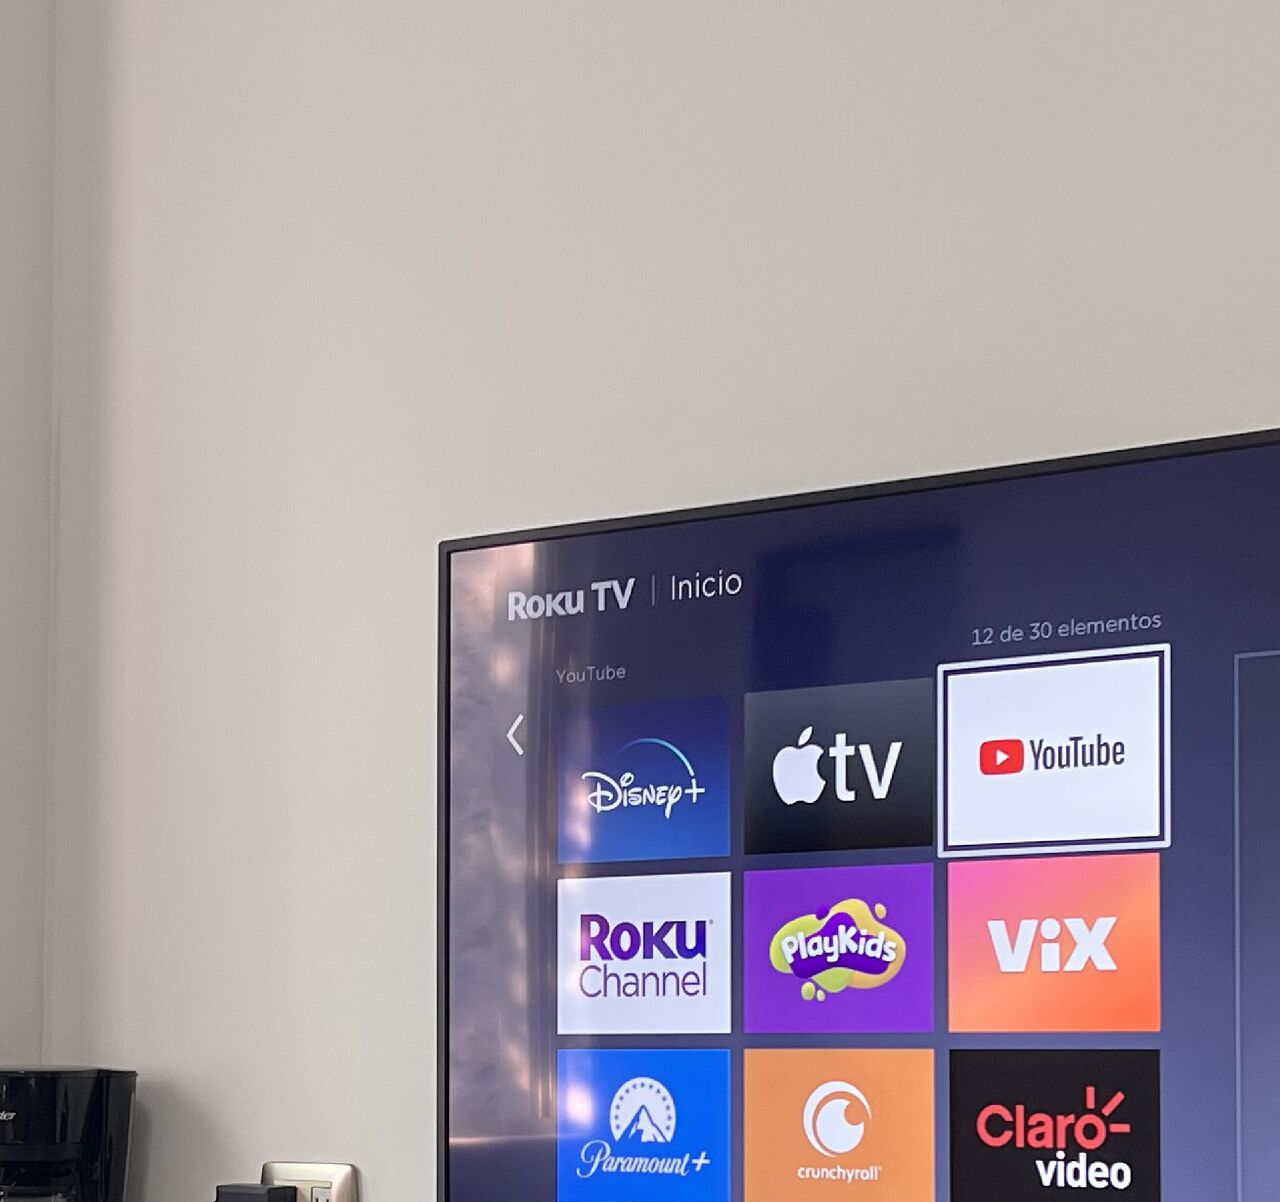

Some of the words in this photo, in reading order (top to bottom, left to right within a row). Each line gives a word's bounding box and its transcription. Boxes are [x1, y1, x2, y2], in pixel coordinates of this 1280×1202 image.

[508, 589, 585, 622] Roku
[591, 577, 636, 612] TV
[671, 569, 743, 601] Inicio
[971, 628, 994, 646] 12
[1000, 625, 1024, 642] de
[1029, 622, 1053, 641] 30
[1058, 613, 1163, 637] elementos
[556, 665, 626, 684] YouTube
[828, 732, 903, 802] tv
[1029, 734, 1126, 771] YouTube
[580, 913, 707, 961] Roku
[781, 924, 897, 964] PlayKids
[579, 961, 707, 998] Channel
[976, 1103, 1108, 1150] Claro
[576, 1139, 711, 1178] Paramount+
[797, 1165, 879, 1184] crunchyroll
[1035, 1150, 1132, 1190] video
